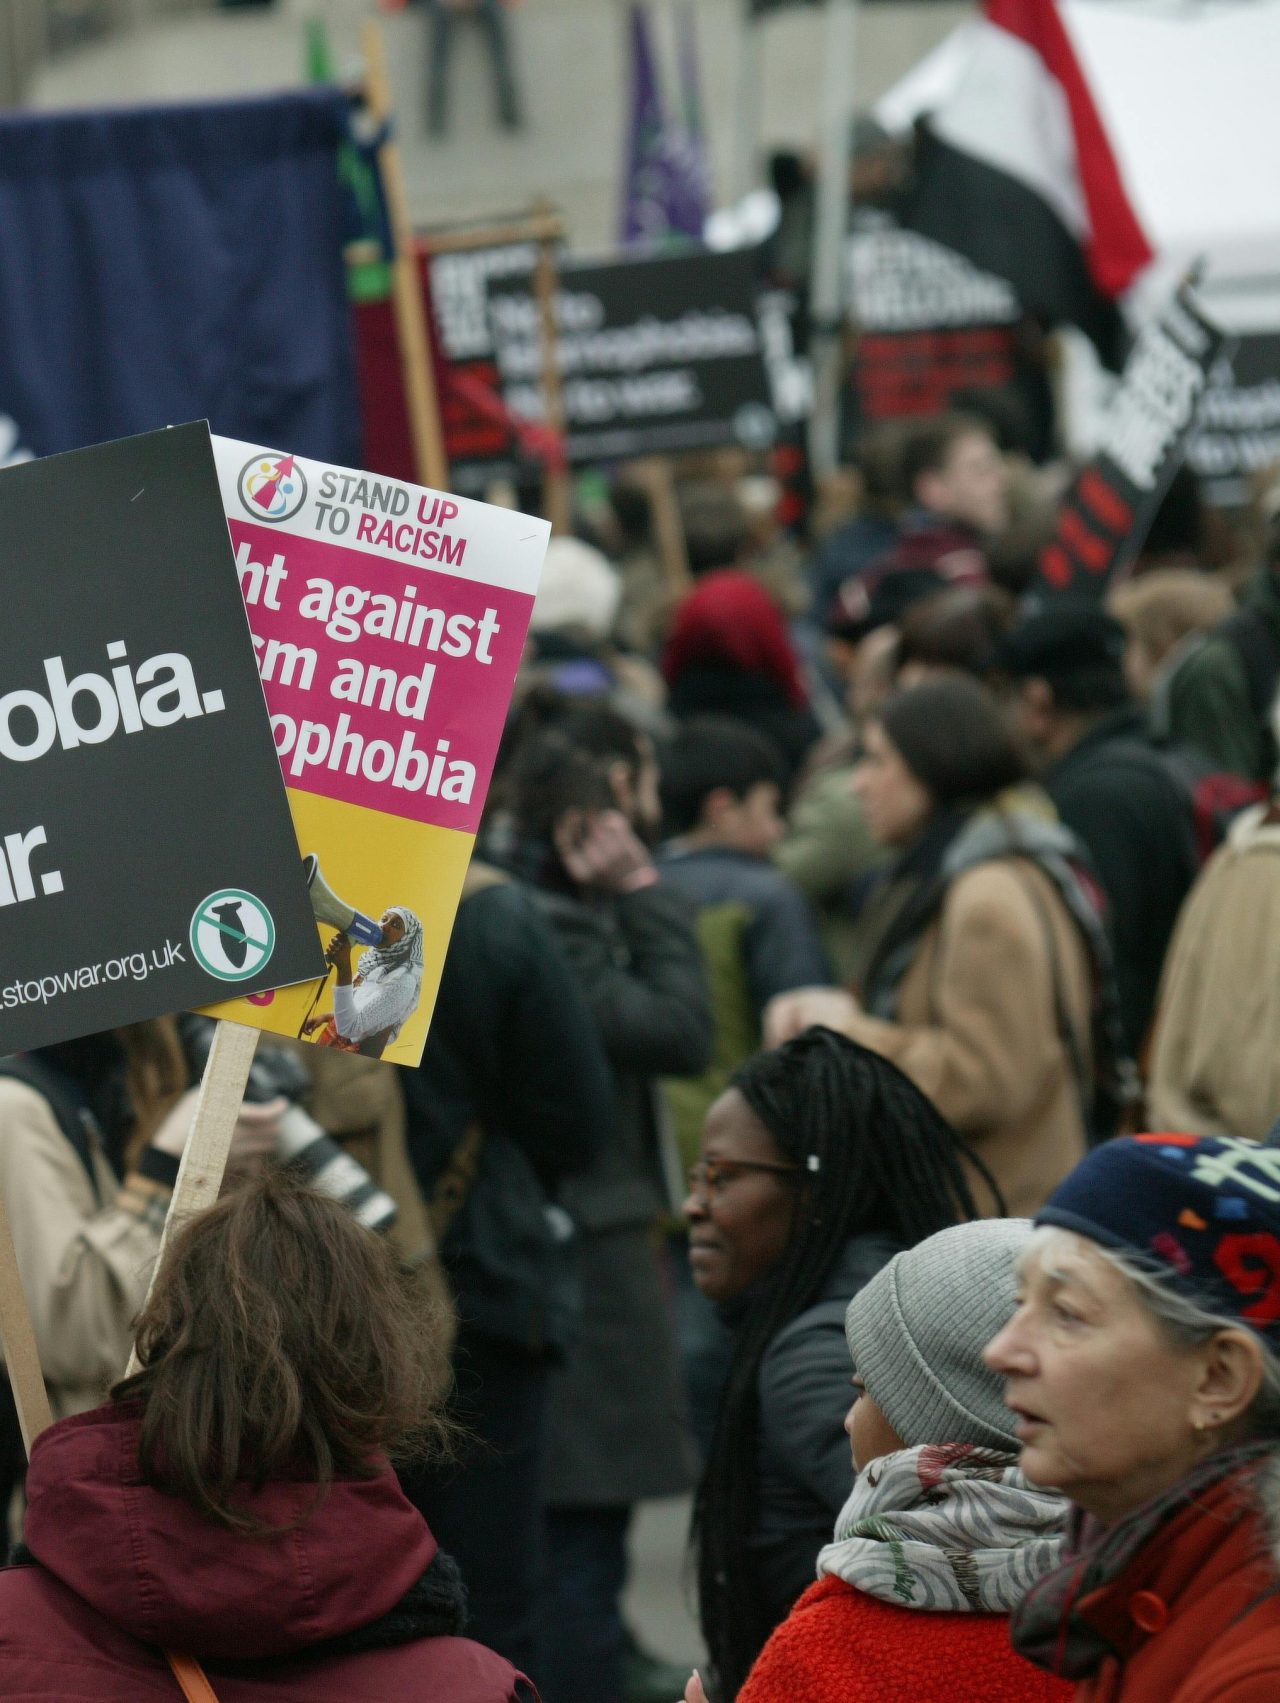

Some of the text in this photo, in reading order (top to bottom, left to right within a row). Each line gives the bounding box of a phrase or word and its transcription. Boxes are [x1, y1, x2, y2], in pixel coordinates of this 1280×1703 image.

[318, 471, 410, 517] STAND
[416, 494, 459, 528] UP
[314, 502, 467, 567] TO RACISM
[298, 577, 501, 665] against
[329, 658, 437, 721] and
